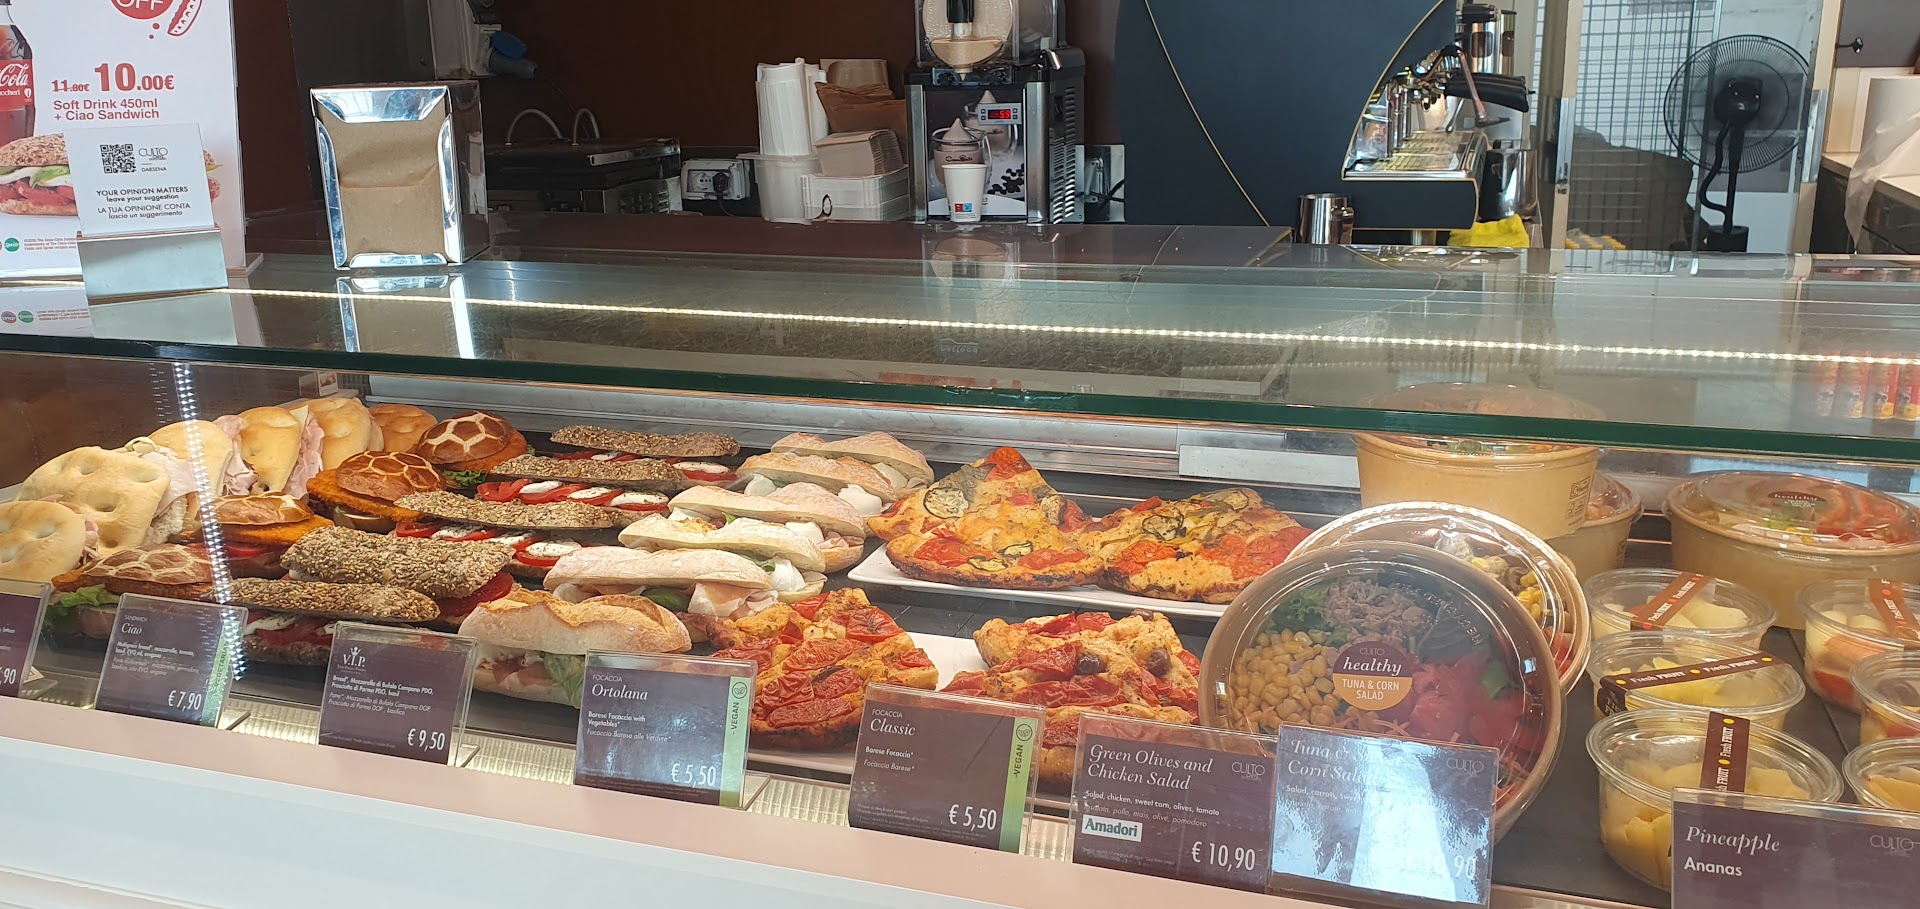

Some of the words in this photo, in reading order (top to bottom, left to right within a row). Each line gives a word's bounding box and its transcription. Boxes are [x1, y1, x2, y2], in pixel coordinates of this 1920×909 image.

[94, 63, 175, 91] 10.00€
[53, 100, 79, 110] Soft
[83, 99, 117, 110] Drink
[120, 98, 158, 108] 450ml
[65, 110, 94, 121] Ciao
[98, 109, 160, 120] Sandwich
[96, 189, 119, 197] YOUR
[124, 204, 162, 212] OPINIONE
[139, 210, 183, 219] suggerimento
[121, 622, 142, 635] Ciao
[343, 654, 366, 668] V.I.P.
[1343, 656, 1402, 677] healthy
[592, 674, 623, 683] FOCACCIA
[1630, 674, 1657, 684] Fresh
[1657, 671, 1686, 680] FRUIT
[1703, 663, 1731, 672] Fresh
[1730, 659, 1758, 668] FRUIT
[591, 683, 648, 701] Ortolana
[1342, 678, 1365, 689] TUNA
[1368, 680, 1374, 690] &
[1376, 680, 1400, 691] CORN
[168, 690, 177, 707] €
[177, 692, 202, 711] 7,90
[1356, 690, 1384, 700] SALAD
[588, 711, 607, 719] Barese
[608, 712, 632, 721] Focaccia
[731, 701, 740, 730] VEGAN
[872, 708, 903, 719] FOCACCIA
[587, 728, 612, 737] Focaccia
[613, 731, 633, 739] Barese
[870, 718, 916, 736] Classic
[1722, 726, 1734, 743] FRUIT
[407, 728, 416, 746] €
[419, 729, 446, 752] 9,50
[865, 745, 886, 755] Barese
[1291, 739, 1330, 759] Tuna
[1720, 743, 1732, 758] Fresh
[863, 758, 890, 769] Focaccia
[1089, 744, 1132, 763] Green
[1135, 750, 1180, 769] Olives
[1184, 758, 1213, 773] and
[1446, 757, 1484, 773] CULTO
[671, 763, 681, 783] €
[684, 765, 717, 788] 5,50
[1088, 763, 1143, 784] Chicken
[1147, 772, 1191, 790] Salad
[1231, 761, 1266, 776] CULTO
[1288, 759, 1326, 778] Corn
[1717, 767, 1729, 785] FRUIT
[1286, 785, 1309, 796] Salad,
[1311, 789, 1337, 800] carrots,
[1085, 790, 1105, 800] Salad,
[1107, 793, 1133, 804] chicken,
[1135, 798, 1154, 807] sweet
[1155, 801, 1171, 810] corn,
[1173, 803, 1195, 813] olives,
[1196, 806, 1220, 816] tomato
[949, 804, 959, 825] €
[962, 806, 997, 831] 5,50
[1133, 811, 1150, 820] mais,
[1152, 813, 1170, 823] olive,
[1172, 817, 1208, 827] pomodoro
[1085, 818, 1138, 837] Amadori
[1686, 826, 1780, 855] Pineapple
[1870, 834, 1914, 851] CULTO
[1191, 841, 1202, 863] €
[1209, 843, 1256, 872] 10,90
[1684, 856, 1743, 877] Ananas
